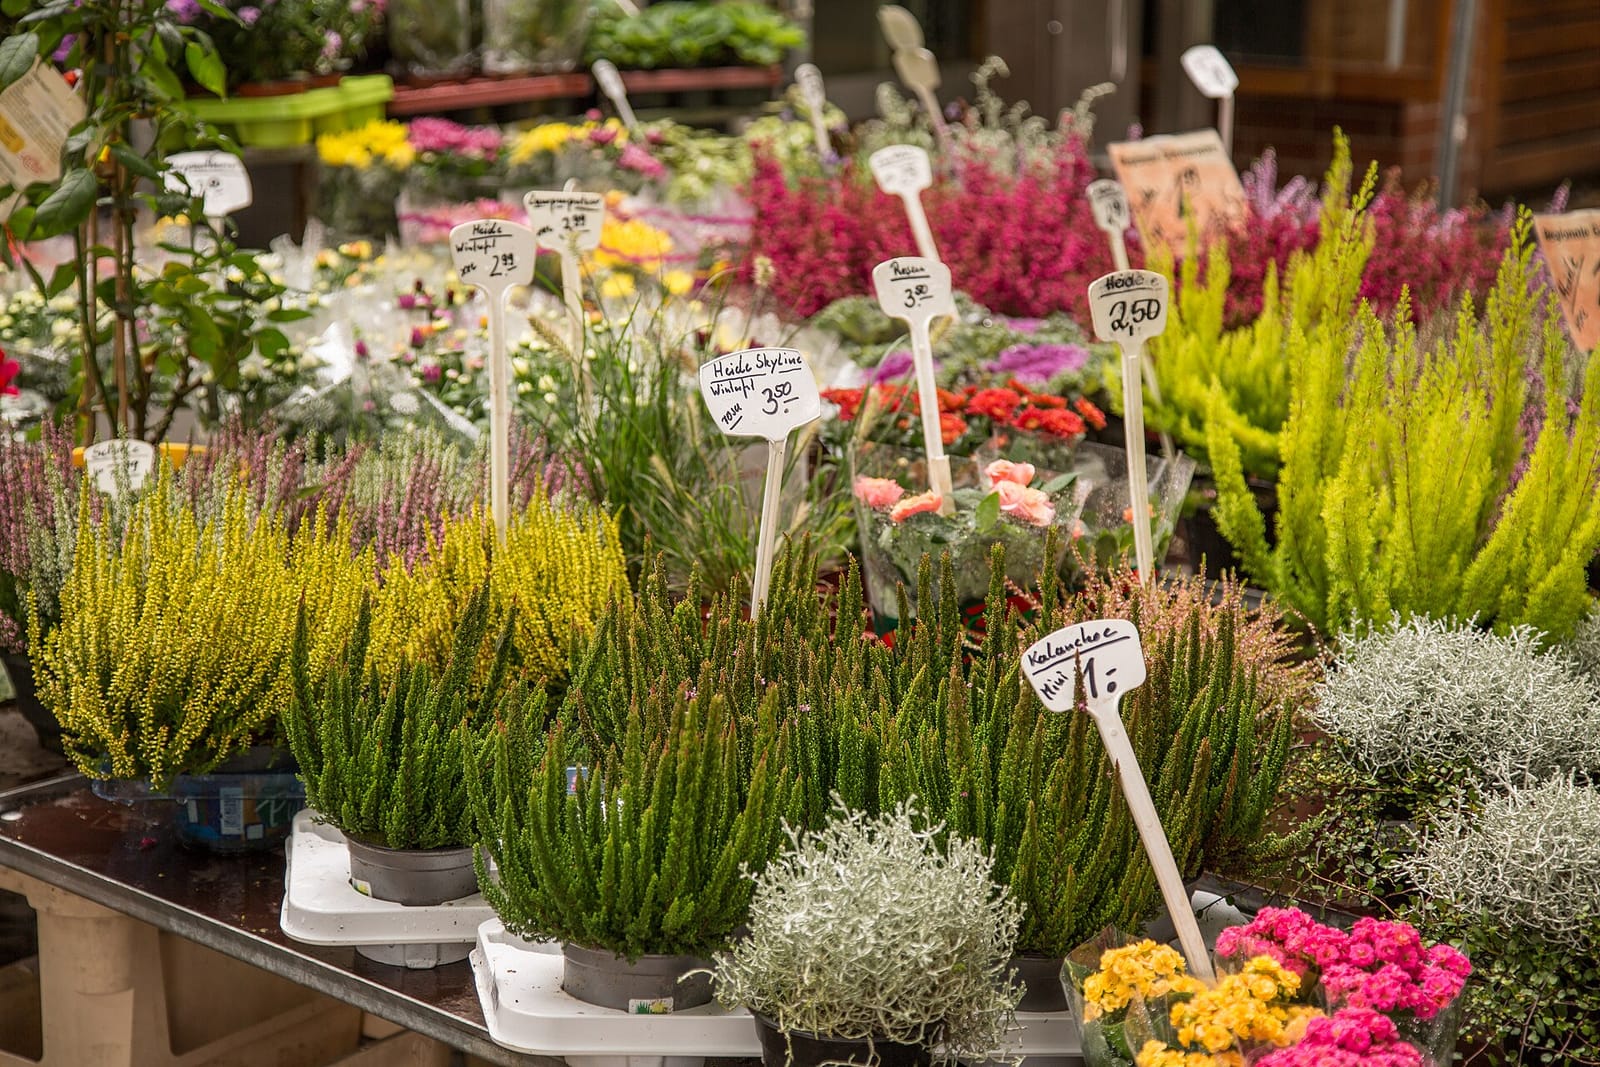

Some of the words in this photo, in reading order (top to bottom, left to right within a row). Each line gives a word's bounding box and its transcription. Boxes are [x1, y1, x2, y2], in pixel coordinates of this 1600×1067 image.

[472, 221, 503, 236] Heide
[889, 261, 926, 276] Rosen
[1109, 298, 1161, 337] 2,50
[712, 354, 753, 378] Heide
[755, 352, 803, 374] Skyline
[1027, 626, 1118, 667] Kalanchoe
[1040, 670, 1069, 701] Mini
